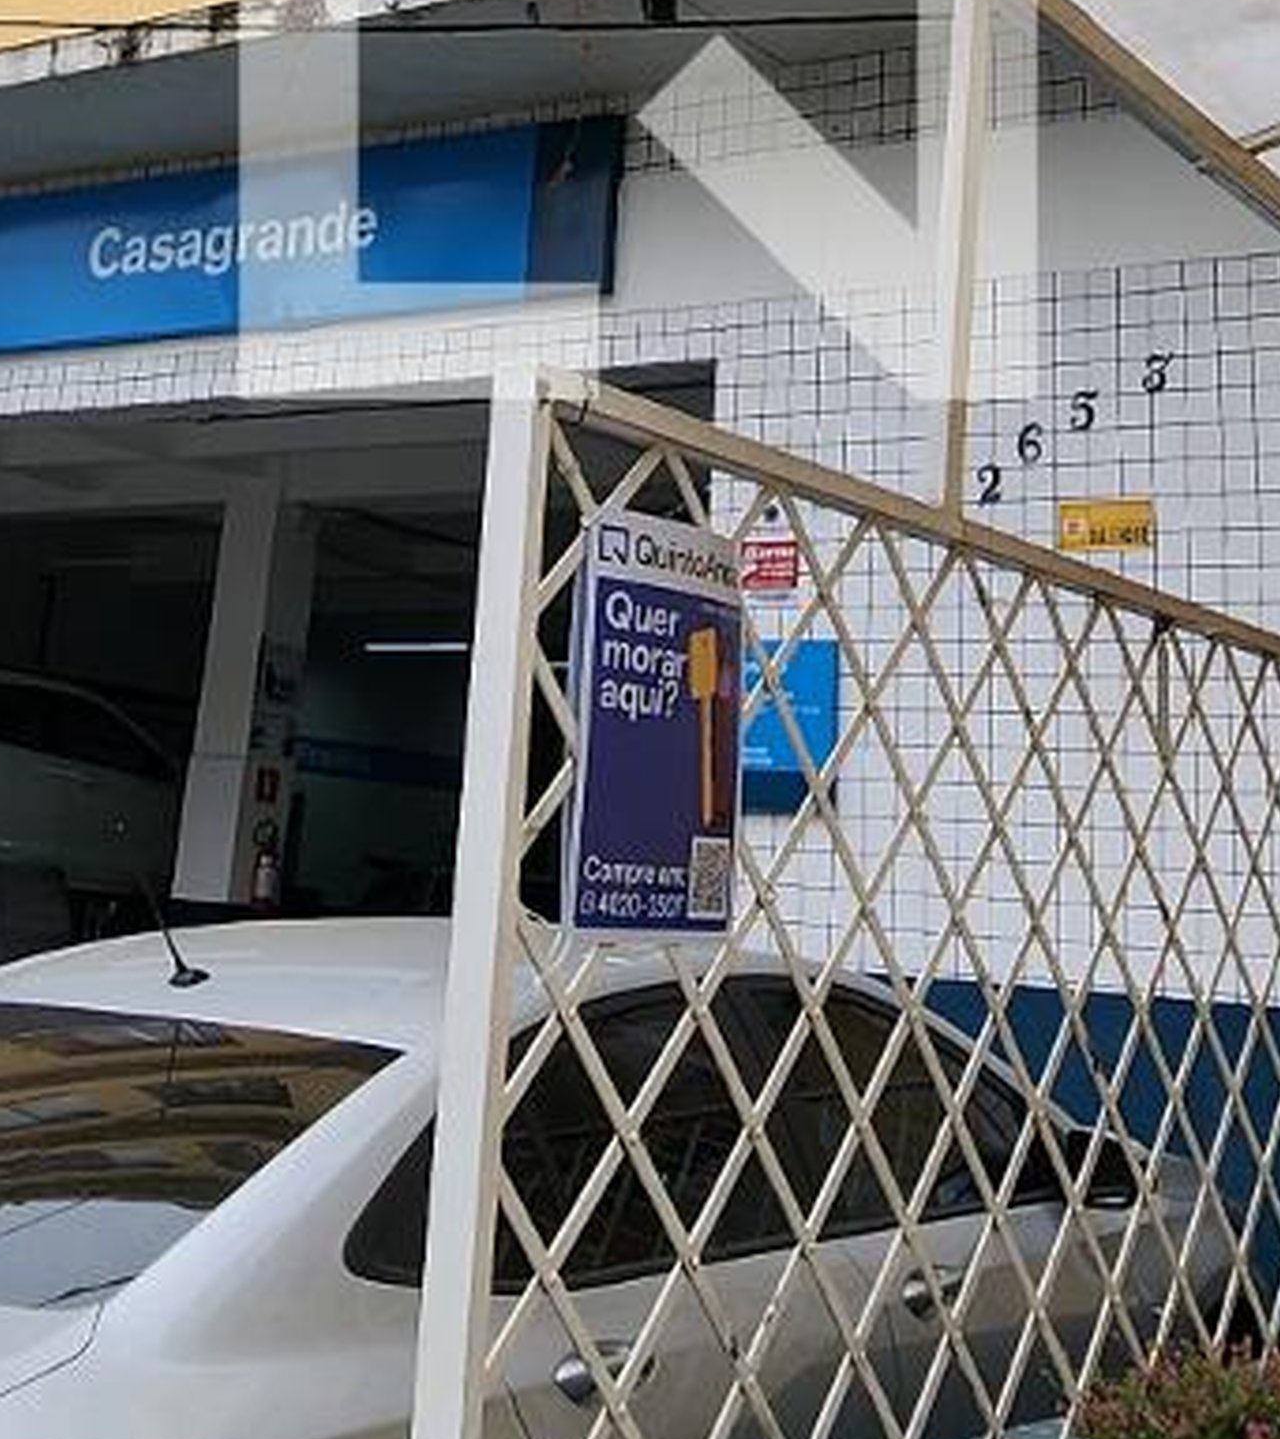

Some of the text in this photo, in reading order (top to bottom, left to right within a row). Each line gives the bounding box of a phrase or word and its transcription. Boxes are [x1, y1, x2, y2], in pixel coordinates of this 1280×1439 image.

[88, 199, 378, 280] Casagrande
[604, 589, 681, 637] Quer
[602, 638, 690, 679] morar
[600, 678, 680, 722] aqui?
